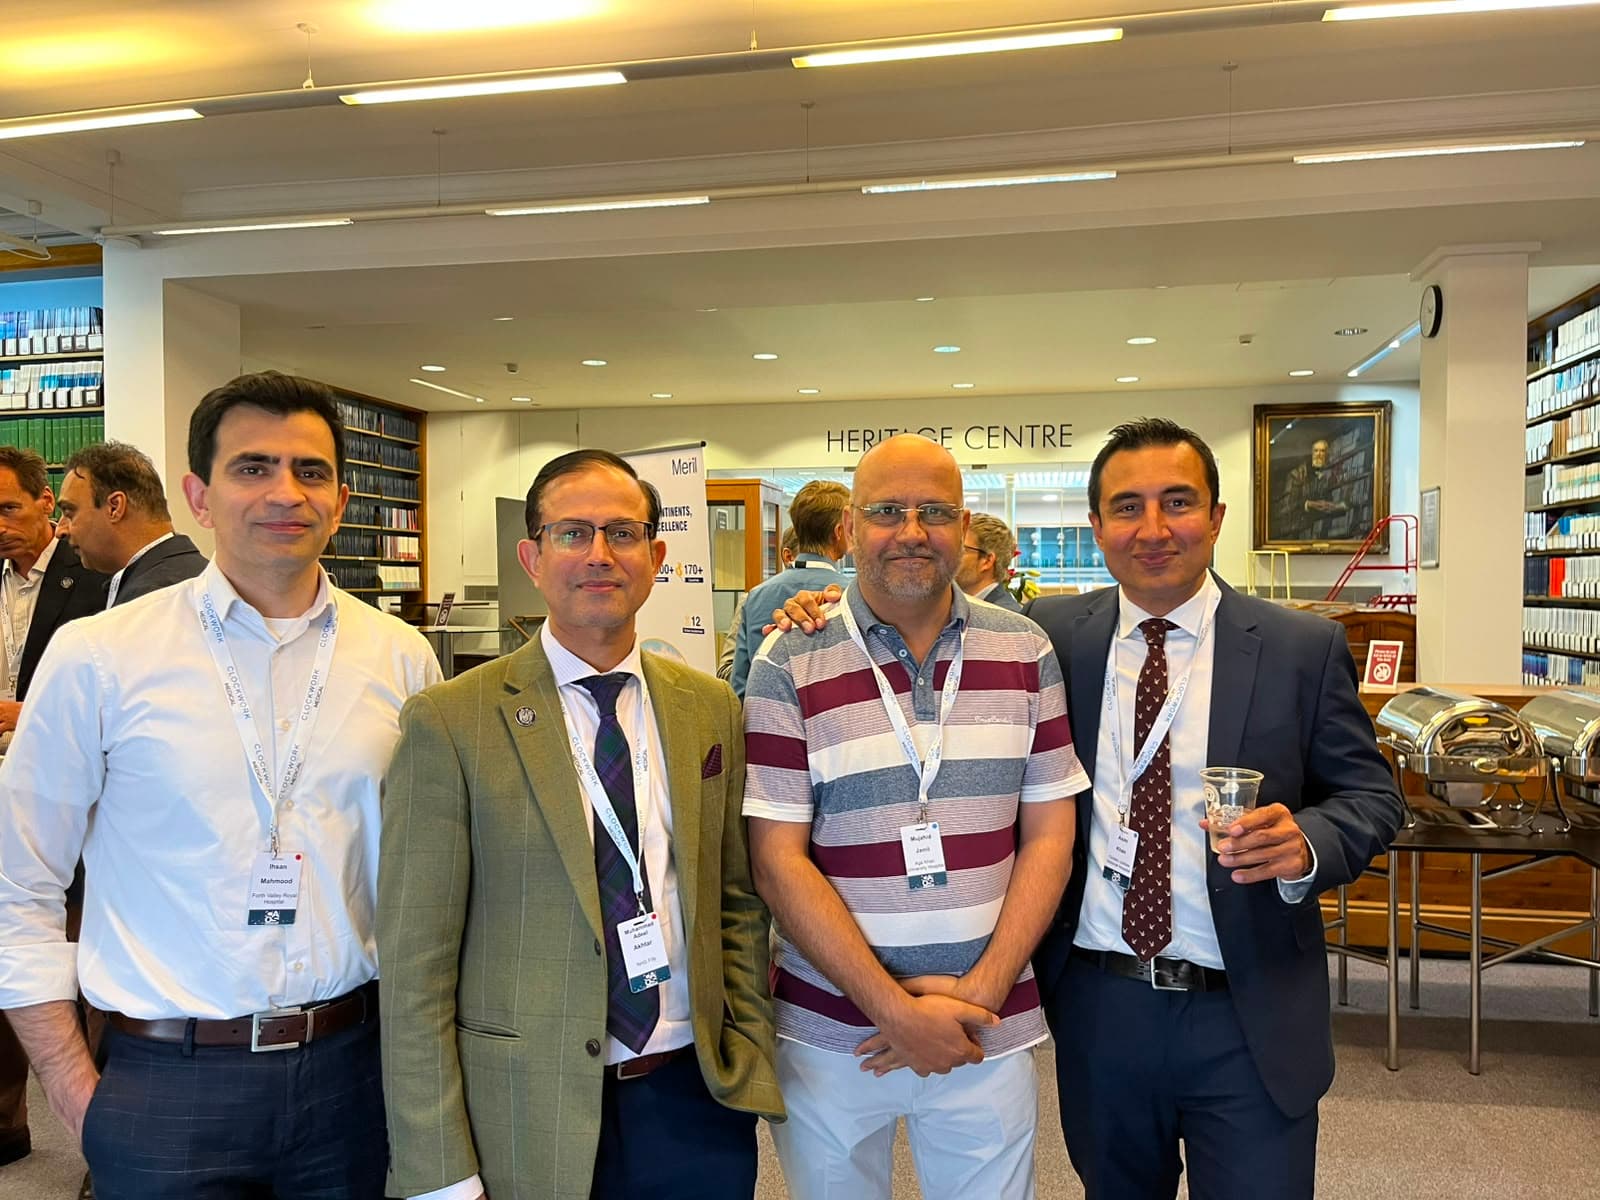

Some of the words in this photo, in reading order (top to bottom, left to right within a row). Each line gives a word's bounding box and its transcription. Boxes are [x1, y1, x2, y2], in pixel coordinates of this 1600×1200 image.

[827, 426, 953, 452] HERITGE
[964, 424, 1073, 450] CENTRE
[672, 457, 698, 476] Meril
[660, 505, 693, 518] NTINENTS,
[657, 564, 674, 574] 00+
[684, 564, 704, 574] 170+
[202, 593, 224, 644] CLOCKWORK
[692, 616, 702, 626] 12
[226, 666, 252, 720] CLOCKWORK
[302, 669, 320, 721] CLOCKWORK
[278, 744, 300, 800] CLOCKWORK
[572, 736, 600, 787] CLOCKWORK
